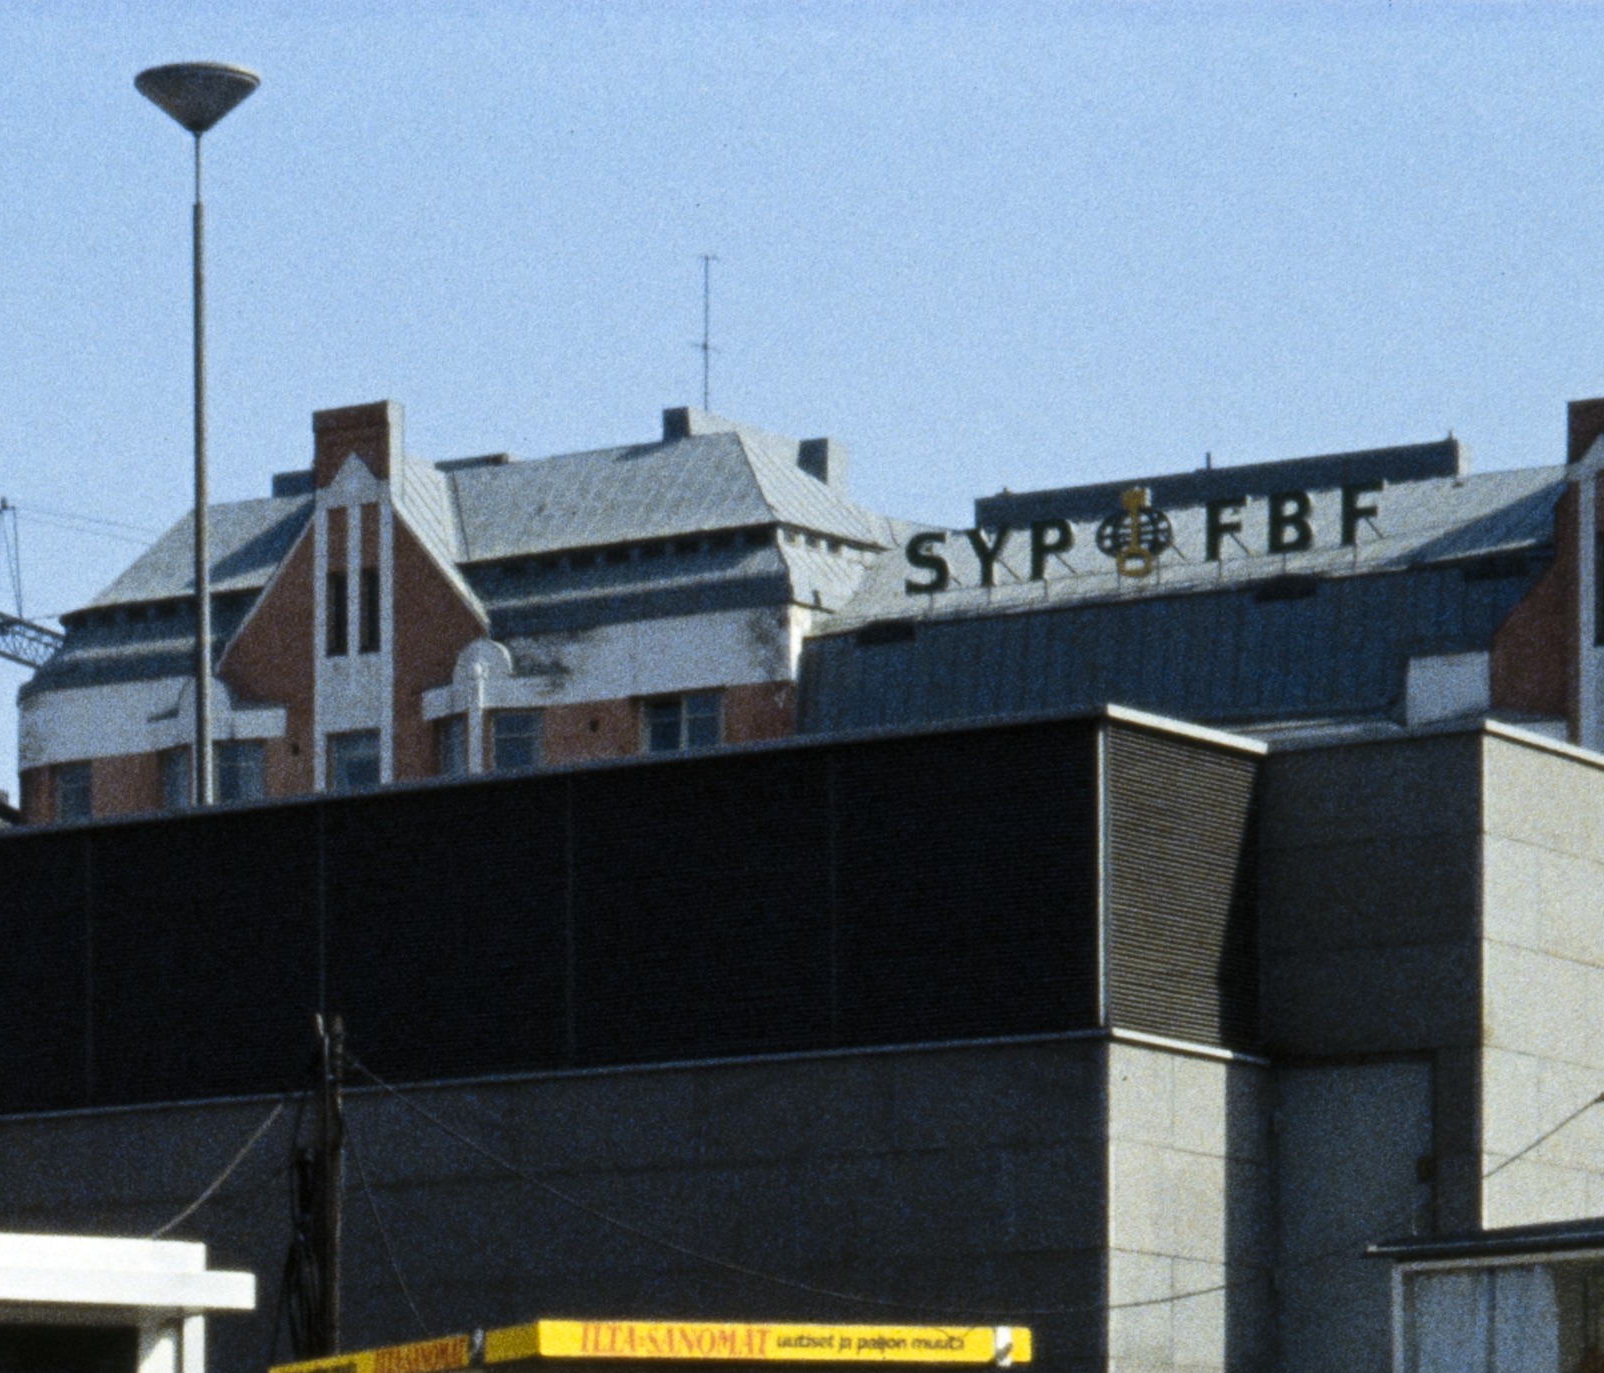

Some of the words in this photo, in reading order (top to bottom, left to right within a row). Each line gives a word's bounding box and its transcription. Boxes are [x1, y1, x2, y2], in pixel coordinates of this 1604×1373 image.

[1205, 480, 1384, 562] FBF
[905, 530, 1074, 596] SYP
[580, 1322, 770, 1357] ILTA-SANOMAT
[777, 1333, 834, 1348] uutiset
